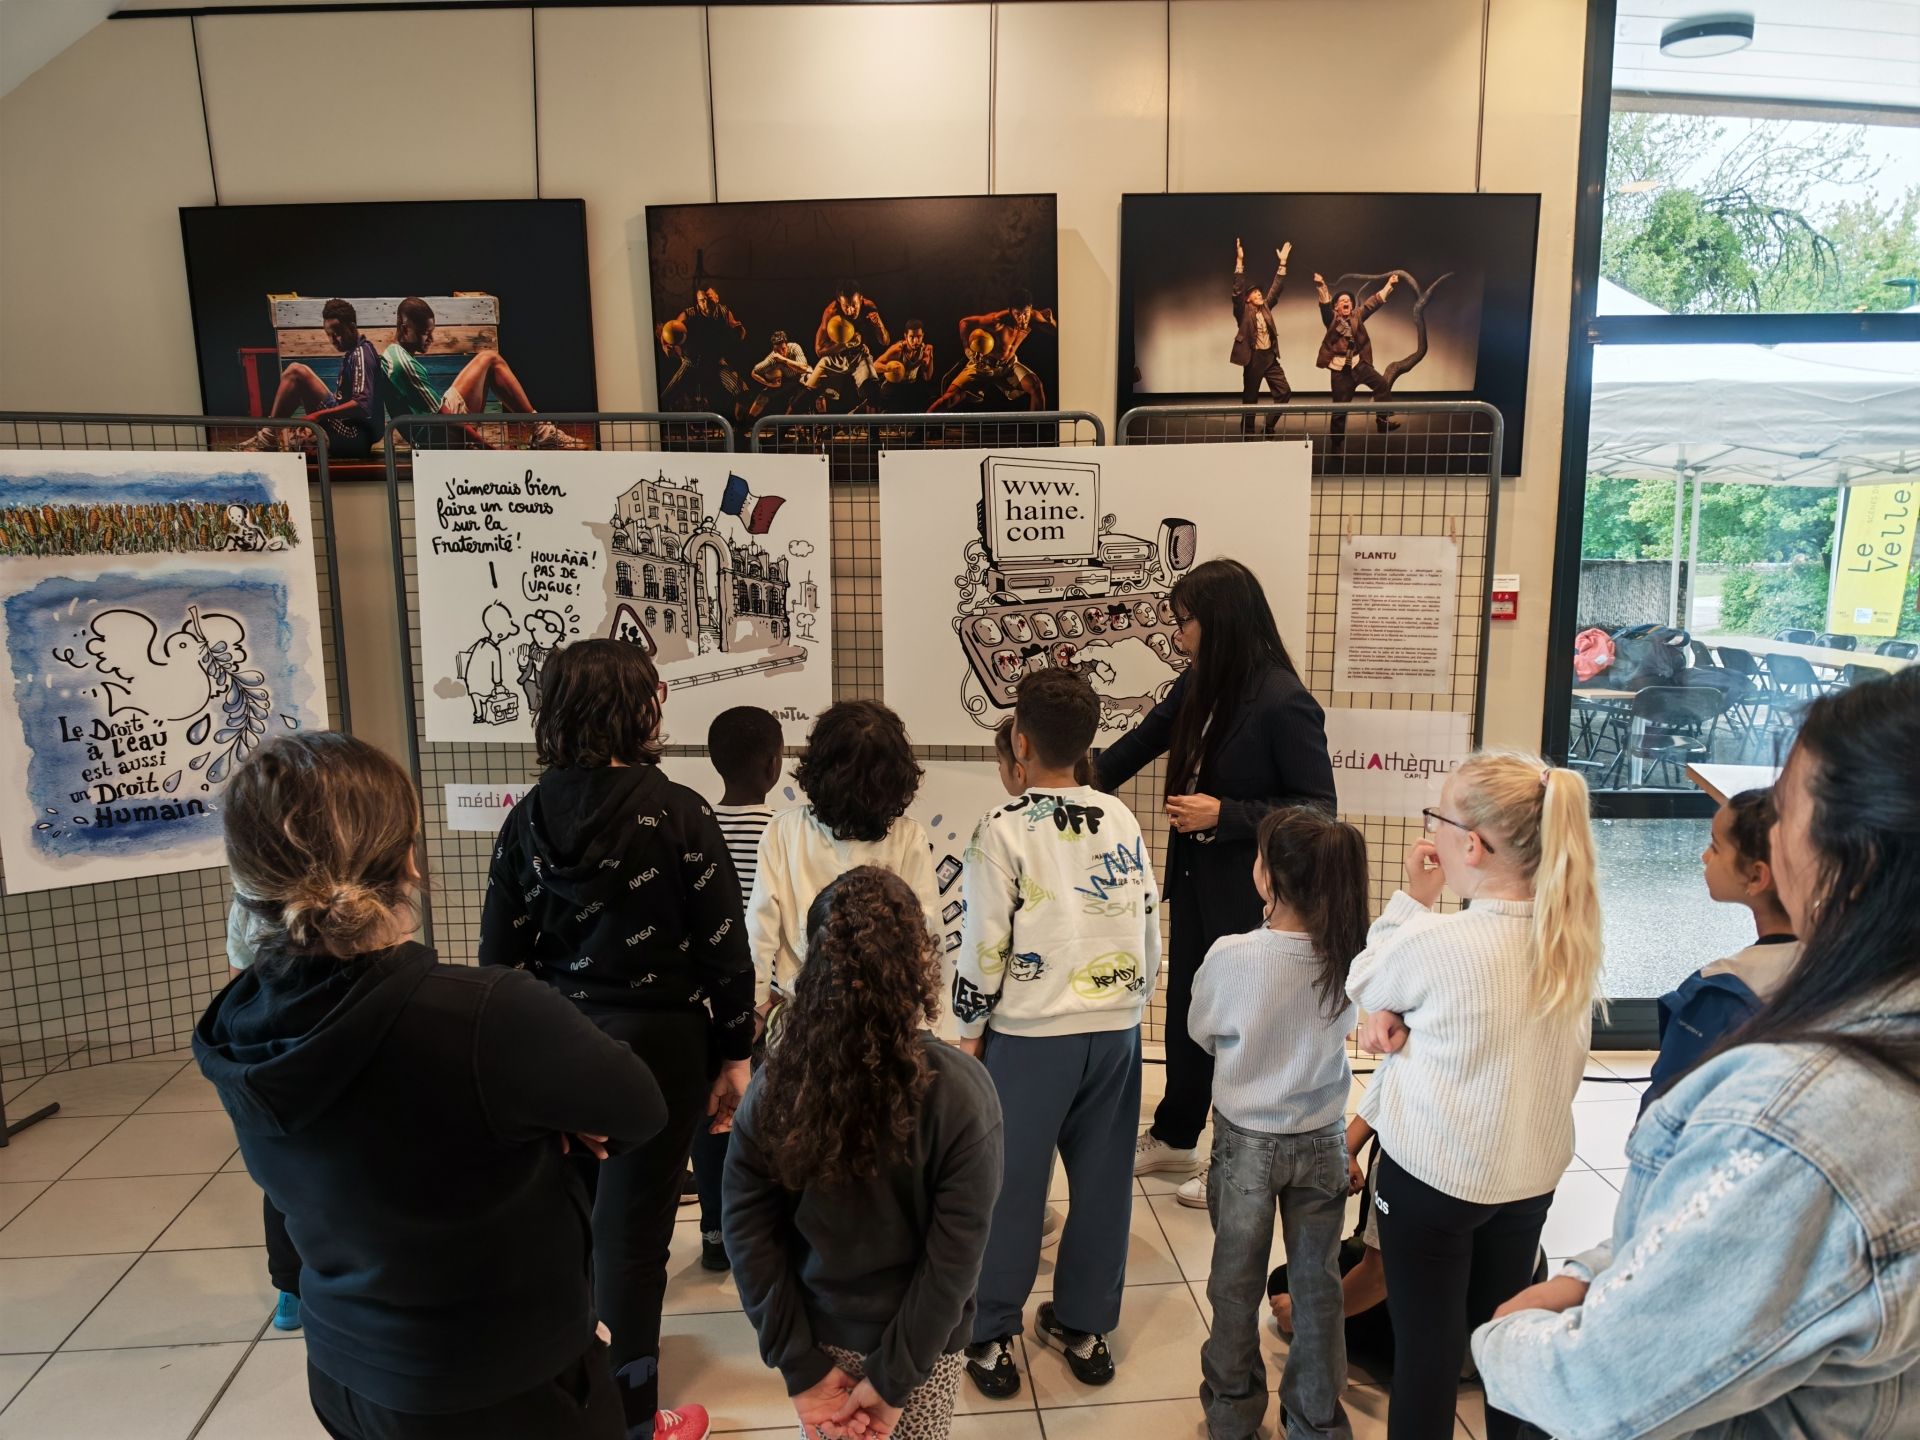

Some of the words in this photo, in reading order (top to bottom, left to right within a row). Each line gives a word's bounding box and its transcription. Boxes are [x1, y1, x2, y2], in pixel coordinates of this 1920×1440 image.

[446, 477, 521, 500] J'aimerais
[525, 469, 566, 497] bien
[1001, 480, 1079, 496] www.
[436, 497, 477, 529] faire
[480, 502, 503, 512] un
[508, 501, 554, 514] cours
[1005, 499, 1085, 521] haine.
[452, 520, 480, 532] sur
[485, 514, 508, 531] la
[1007, 526, 1066, 542] com
[1354, 551, 1397, 560] PLANTU
[1848, 543, 1874, 572] Le
[534, 564, 555, 578] PAS
[560, 567, 578, 579] DE
[58, 716, 83, 743] Le
[89, 713, 144, 741] Droit
[86, 743, 103, 761] à
[82, 760, 113, 782] est
[118, 751, 167, 775] aussi
[69, 789, 91, 803] un
[93, 772, 159, 805] Droit
[95, 798, 205, 828] Humain
[628, 867, 660, 890] NASA
[693, 862, 718, 891] NASA
[625, 925, 656, 947] NASA
[709, 918, 734, 946] NASA
